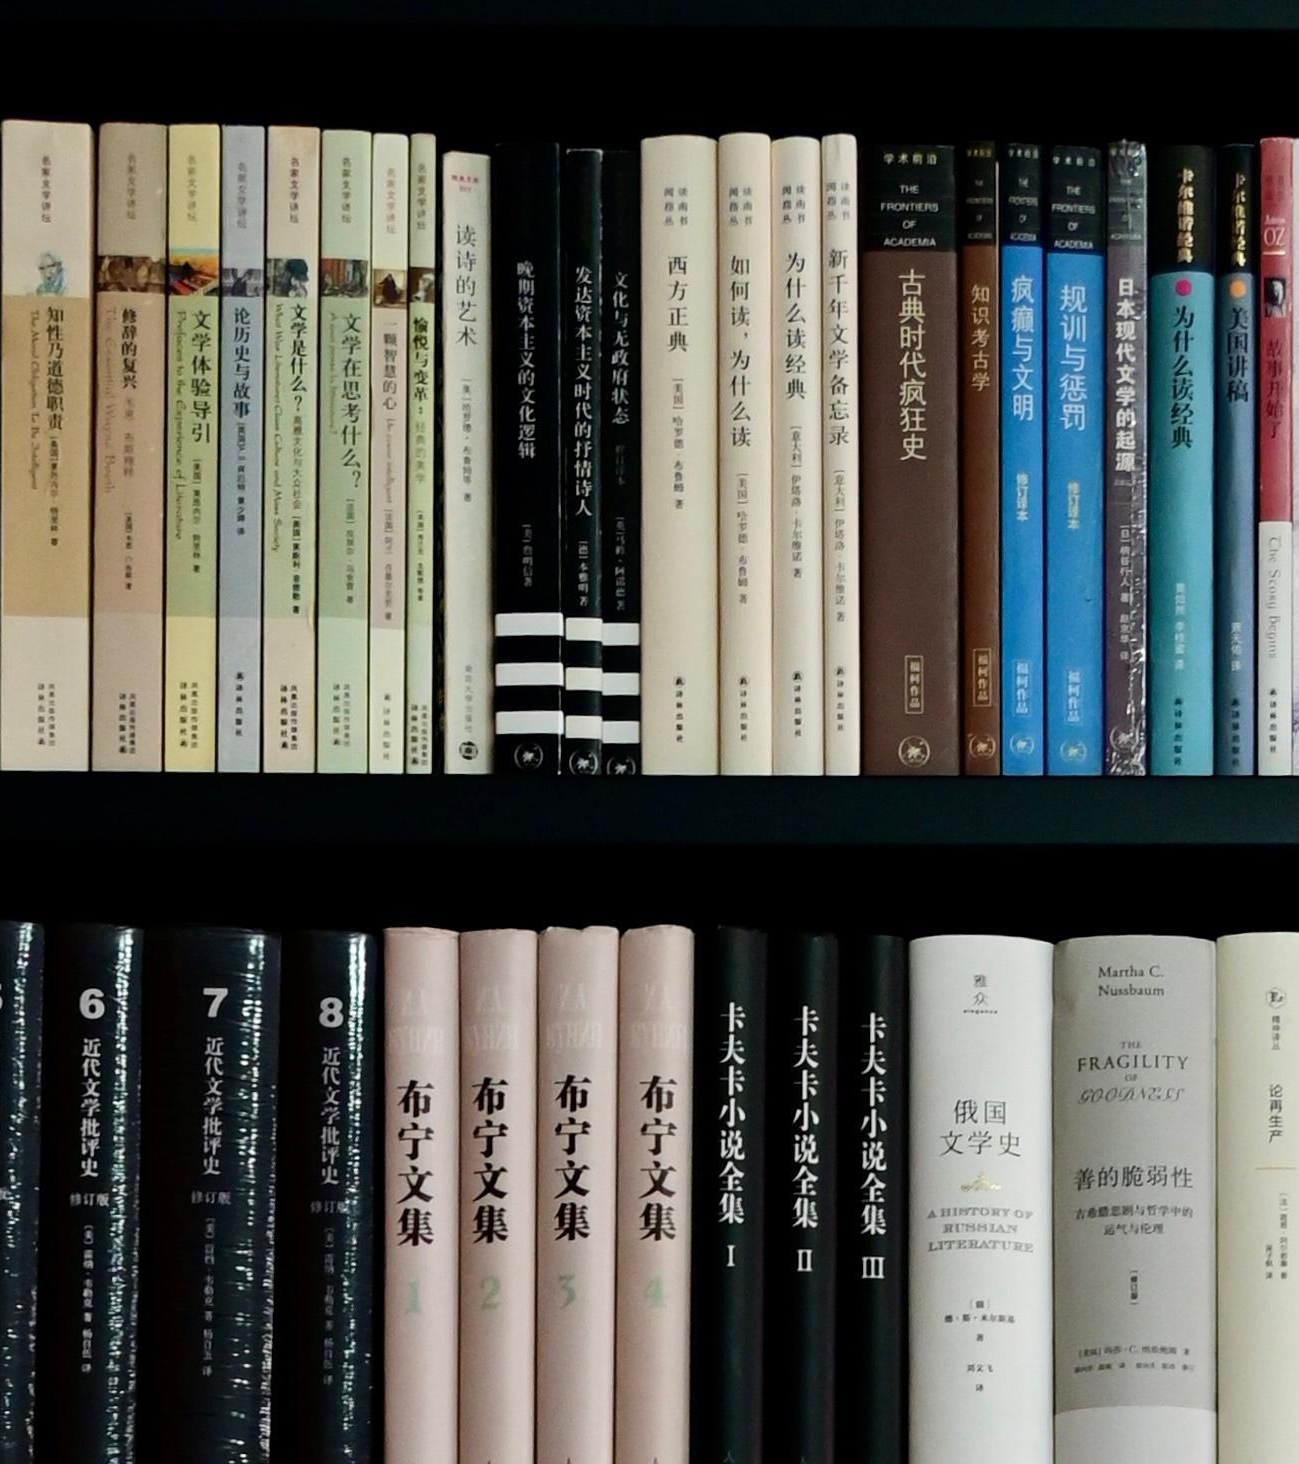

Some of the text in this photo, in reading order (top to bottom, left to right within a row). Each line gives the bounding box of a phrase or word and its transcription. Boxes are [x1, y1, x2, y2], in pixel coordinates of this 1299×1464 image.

[880, 202, 939, 213] FRONTIERS
[883, 237, 937, 247] ACADEMIA
[899, 184, 920, 195] THE
[901, 219, 917, 230] OF
[517, 260, 536, 459] 晚期资本主义的文化逻辑
[668, 256, 688, 353] 西方正典
[731, 255, 751, 447] 如何读，为什么读
[786, 251, 806, 400] 为什么读经典
[829, 248, 849, 446] 新千年文学备忘录
[899, 268, 927, 461] 古典时代疯狂史
[971, 283, 990, 392] 知识考古学
[1011, 274, 1034, 422] 疯癫与文明
[1059, 284, 1087, 431] 规训与惩罚
[574, 265, 593, 517] 发达资本主义时代的抒情诗人
[1171, 305, 1194, 449] 为什么读经典
[1097, 964, 1165, 978] Martha C.
[1097, 984, 1165, 997] Nussbaum
[720, 1001, 746, 1225] 卡夫卡小说全集
[793, 1005, 819, 1229] 卡夫卡小说全集
[861, 1011, 887, 1236] 卡夫卡小说全集
[954, 1099, 1007, 1125] 俄国
[1077, 1054, 1189, 1071] FRAGILITY
[397, 1079, 434, 1247] 布宁文集
[473, 1076, 509, 1244] 布宁文集
[554, 1074, 591, 1241] 布宁文集
[640, 1075, 676, 1242] 布宁文集
[940, 1130, 1021, 1157] 文学史
[1075, 1165, 1193, 1190] 善的脆弱性
[927, 1239, 1034, 1253] LITERATURE
[942, 1222, 1019, 1234] RUSSIAN
[1075, 1204, 1194, 1219] 古希腊悲剧与哲学中的
[1103, 1222, 1165, 1236] 运气与伦理
